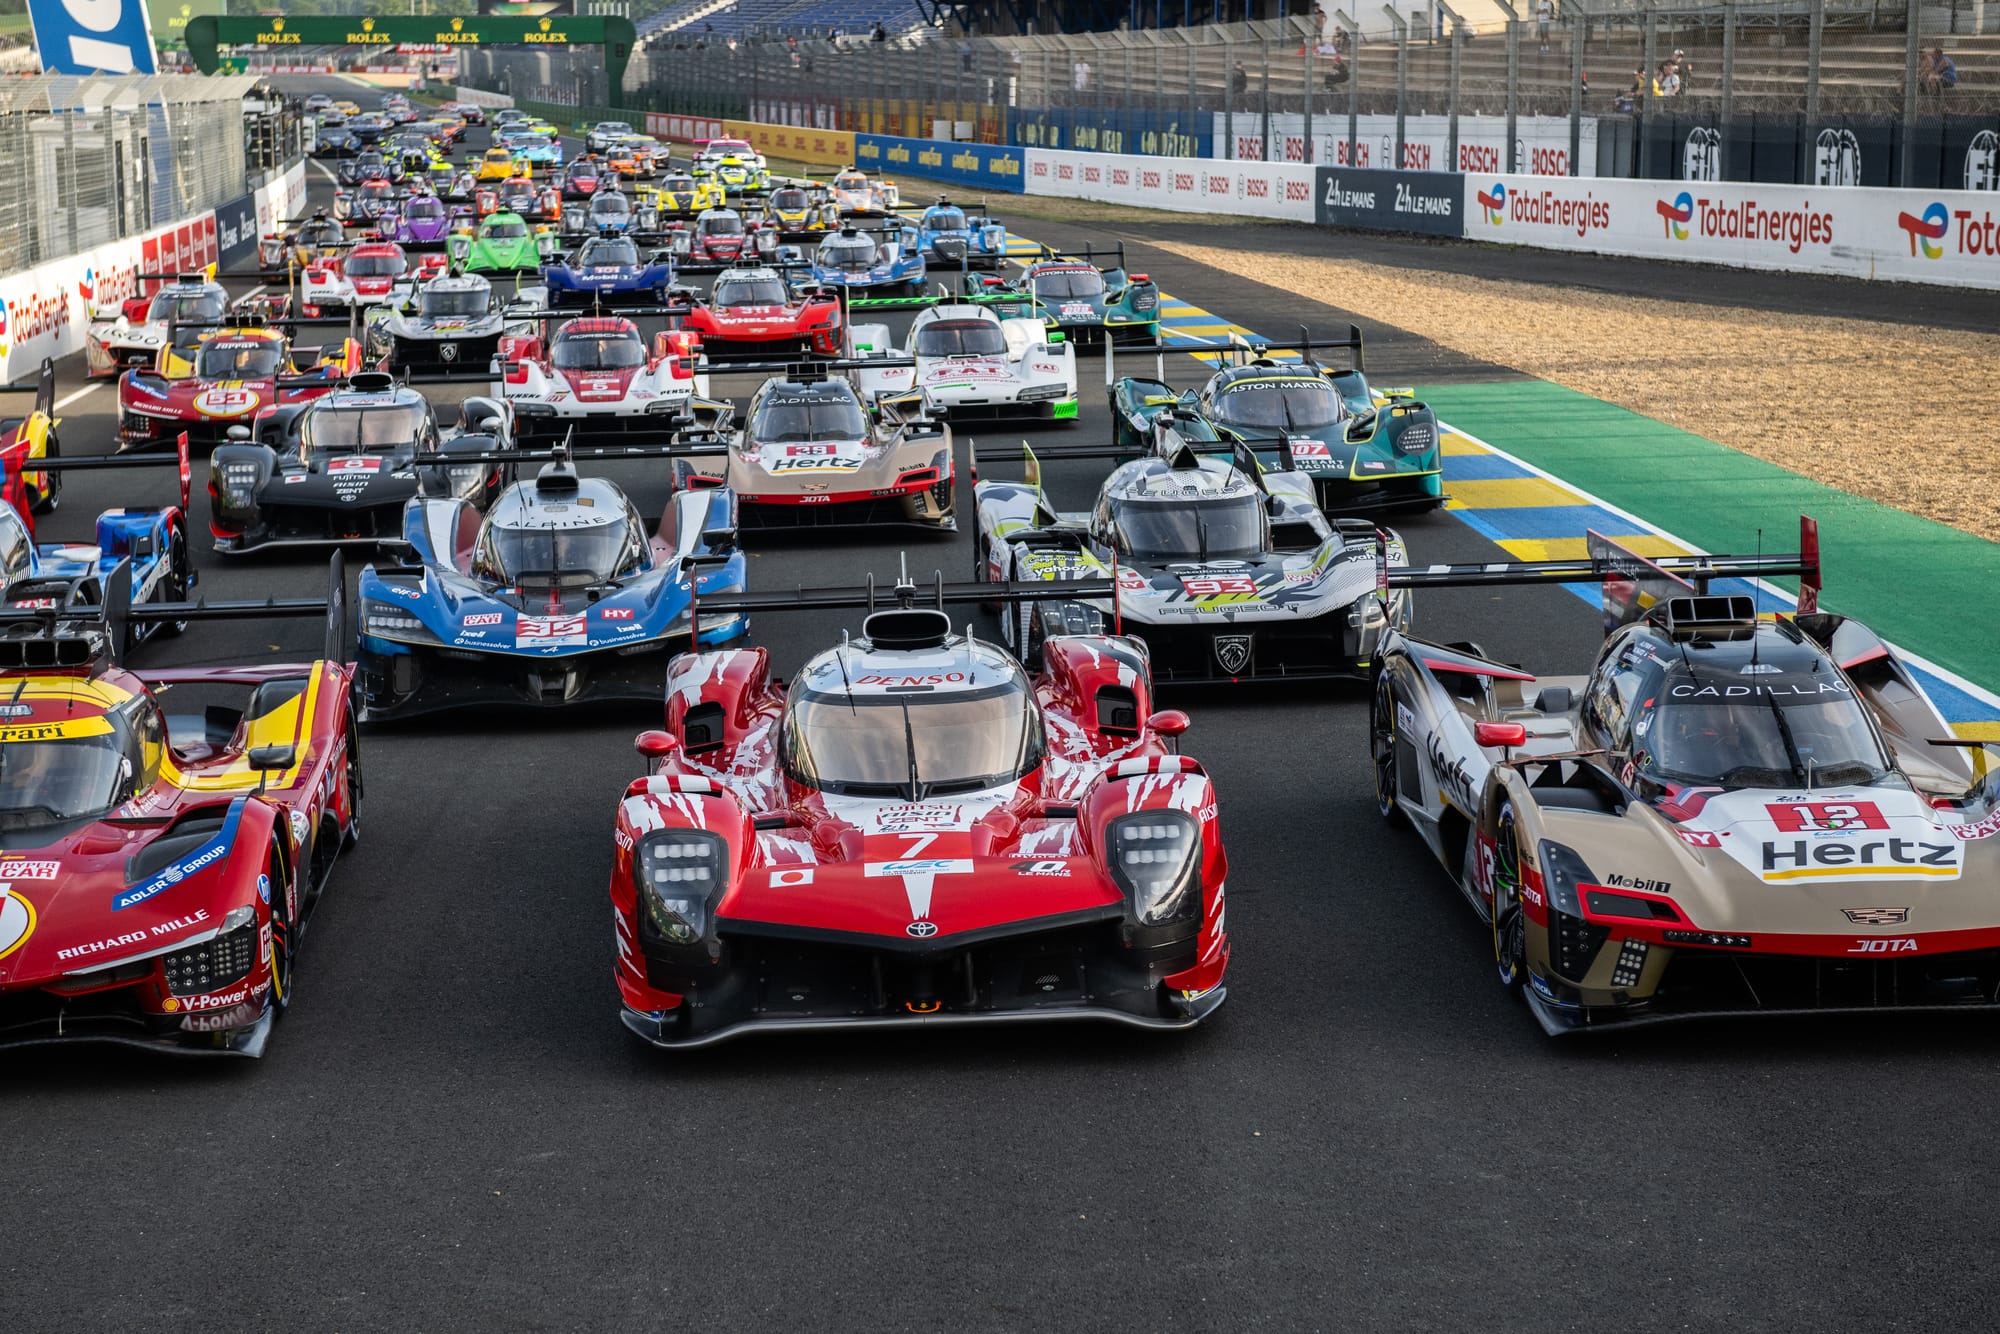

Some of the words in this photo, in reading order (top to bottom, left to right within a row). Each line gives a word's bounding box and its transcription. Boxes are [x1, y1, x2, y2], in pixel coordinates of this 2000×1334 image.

[257, 33, 300, 43] ROLEX
[347, 33, 390, 43] ROLEX
[436, 33, 479, 43] ROLEX
[524, 33, 567, 43] ROLEX
[1460, 144, 1498, 173] BOSCH
[1815, 145, 1855, 186] FIA
[1034, 162, 1047, 176] BOSCH
[1059, 164, 1072, 179] BOSCH
[1085, 167, 1100, 182] BOSCH
[1113, 169, 1129, 185] BOSCH
[1143, 171, 1160, 188] BOSCH
[1175, 174, 1194, 190] BOSCH
[1210, 176, 1229, 193] BOSCH
[1247, 178, 1267, 197] BOSCH
[1286, 181, 1309, 200] BOSCH
[1341, 190, 1351, 207] LE
[1351, 191, 1375, 209] MANS
[1412, 195, 1424, 213] LE
[1425, 196, 1451, 216] MANS
[1508, 189, 1609, 237] TotalEnergies
[1698, 199, 1833, 253] TotalEnergies
[720, 316, 795, 325] WHELEN
[593, 383, 608, 391] 5
[1229, 382, 1276, 394] ASTON
[1280, 380, 1331, 391] MARTIN
[209, 392, 245, 404] 51
[767, 396, 851, 405] CADILLAC
[795, 445, 827, 455] 38
[345, 460, 364, 468] 8
[773, 458, 861, 470] Hertz
[508, 516, 607, 528] ALPINE
[1035, 564, 1087, 577] yahoo!
[1187, 580, 1252, 593] 93
[604, 609, 631, 618] HY
[1159, 602, 1300, 615] PEUGEOT
[465, 617, 499, 625] CAR
[616, 623, 643, 633] bell
[519, 620, 584, 637] 35
[463, 639, 511, 648] businessolver
[599, 632, 647, 645] businessolver
[855, 672, 965, 686] DENSO
[1671, 680, 1850, 697] CADILLAC
[879, 804, 952, 812] FUJITSU
[898, 833, 938, 858] 7
[1761, 838, 1958, 870] Hertz
[1, 868, 53, 878] CAR
[120, 880, 168, 907] ADLER
[182, 845, 226, 873] GROUP
[1607, 874, 1655, 891] Mobil
[57, 930, 147, 960] RICHARD
[151, 909, 210, 936] MILLE
[1847, 938, 1918, 953] JOTA
[183, 989, 248, 1010] V-Power
